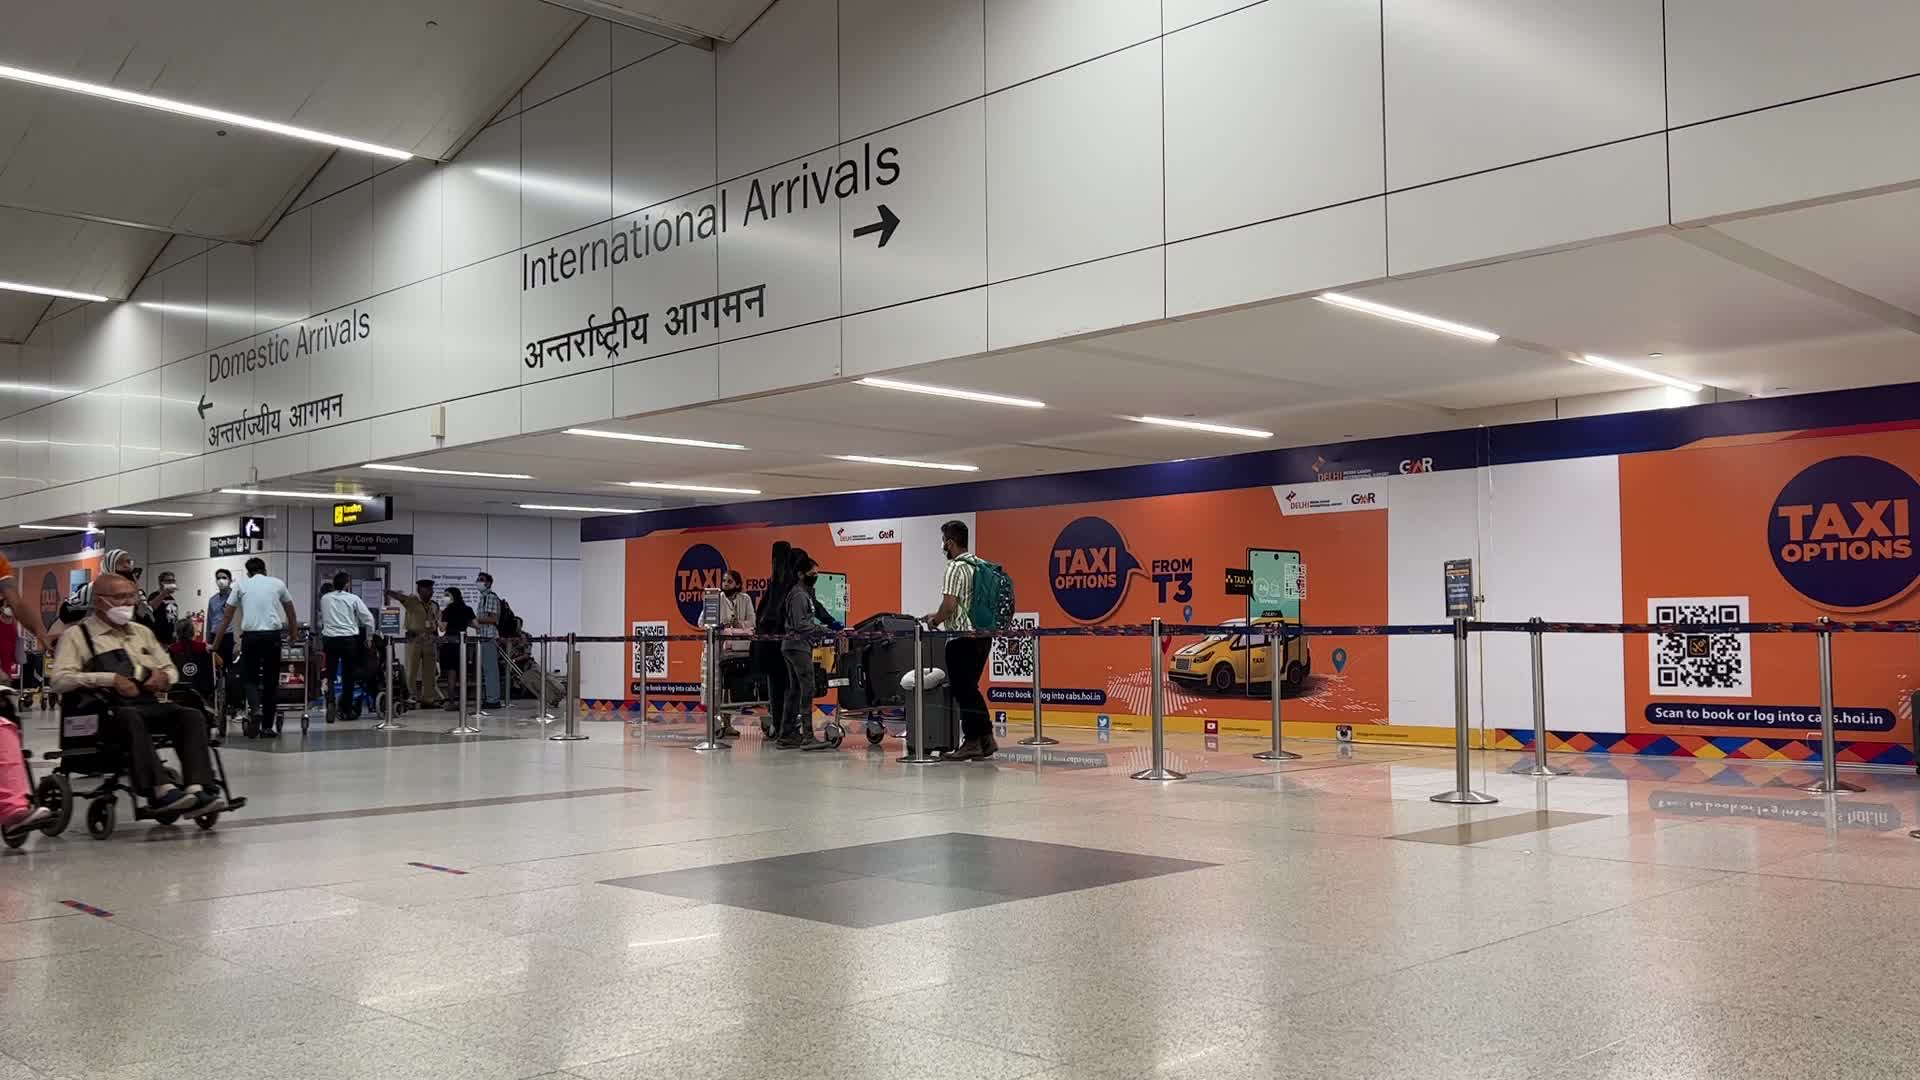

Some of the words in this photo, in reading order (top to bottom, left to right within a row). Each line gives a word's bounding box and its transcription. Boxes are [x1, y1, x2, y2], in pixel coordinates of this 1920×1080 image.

[523, 189, 727, 291] International
[743, 142, 901, 227] Arrivals
[524, 305, 649, 369] अन्तर्राष्ट्रीय
[664, 283, 767, 338] आगमन
[208, 334, 290, 384] Domestic
[295, 308, 371, 359] Arrivals
[208, 402, 282, 447] अन्तर्राज्यीय
[289, 393, 344, 428] आगमन
[1777, 498, 1909, 541] TAXI
[355, 535, 374, 543] Care
[376, 536, 399, 544] Room
[1781, 538, 1913, 563] OPTIONS
[1054, 546, 1117, 575] TAXI
[1152, 558, 1193, 573] FROM
[1055, 573, 1118, 590] OPTIONS
[1152, 573, 1193, 604] T3
[992, 690, 1007, 699] Scan
[1007, 690, 1015, 699] to
[1015, 690, 1032, 699] book
[1051, 692, 1064, 700] into
[1655, 707, 1684, 719] Scan
[1687, 709, 1700, 719] to
[1702, 708, 1735, 720] book
[1737, 711, 1751, 721] or
[1754, 710, 1775, 724] log
[1778, 711, 1805, 722] into
[1808, 712, 1884, 725] cas.hoi.in
